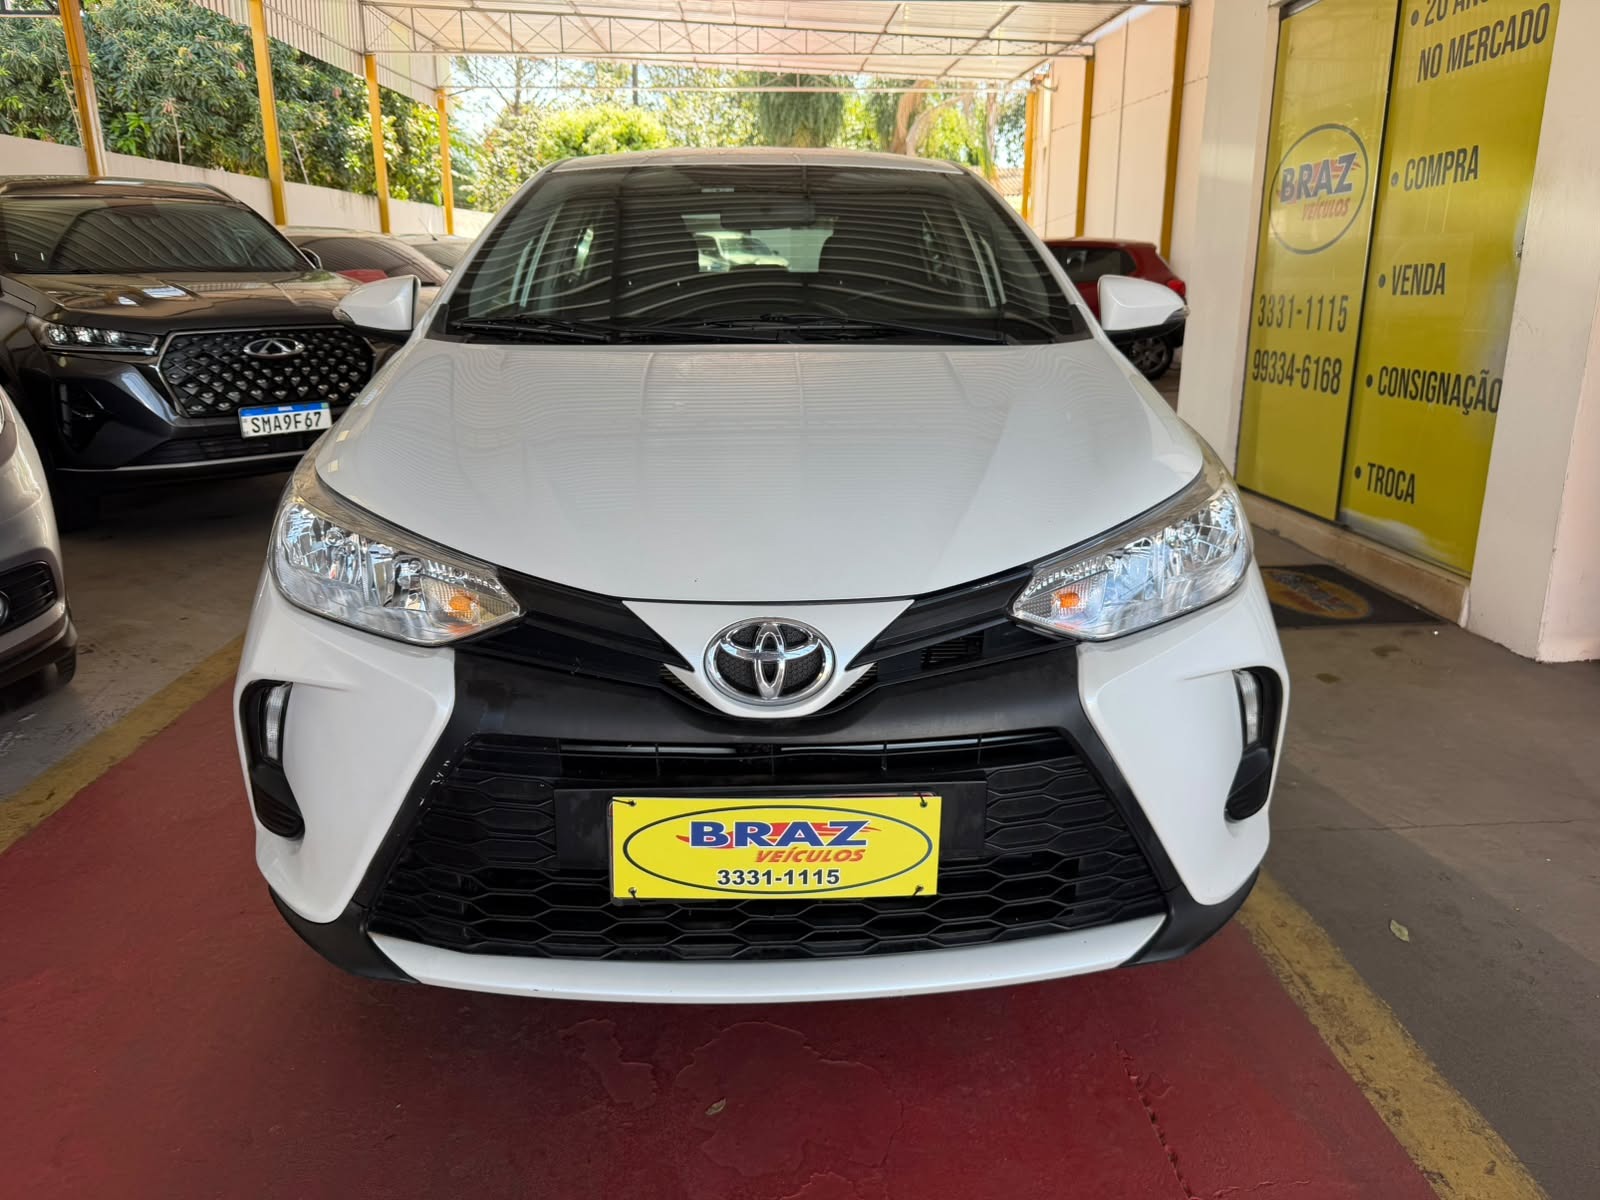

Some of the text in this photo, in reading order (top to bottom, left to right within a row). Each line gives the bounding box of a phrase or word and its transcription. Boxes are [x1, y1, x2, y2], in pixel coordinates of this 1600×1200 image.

[1424, 0, 1448, 27] 20
[1417, 2, 1550, 83] NO MERCADO
[1280, 152, 1357, 203] BRAZ
[1403, 145, 1479, 191] COMPRA
[1391, 262, 1446, 296] VENDA
[1257, 294, 1349, 333] 3331-1115
[1252, 348, 1342, 395] 99334-6168
[1377, 365, 1503, 415] CONSIGNAÇÃO
[251, 411, 322, 434] SMA9F67
[1367, 462, 1416, 504] TROCA
[689, 820, 869, 848] BRAZ
[755, 847, 865, 863] VEÍCULOS
[717, 869, 840, 885] 3331-1115
